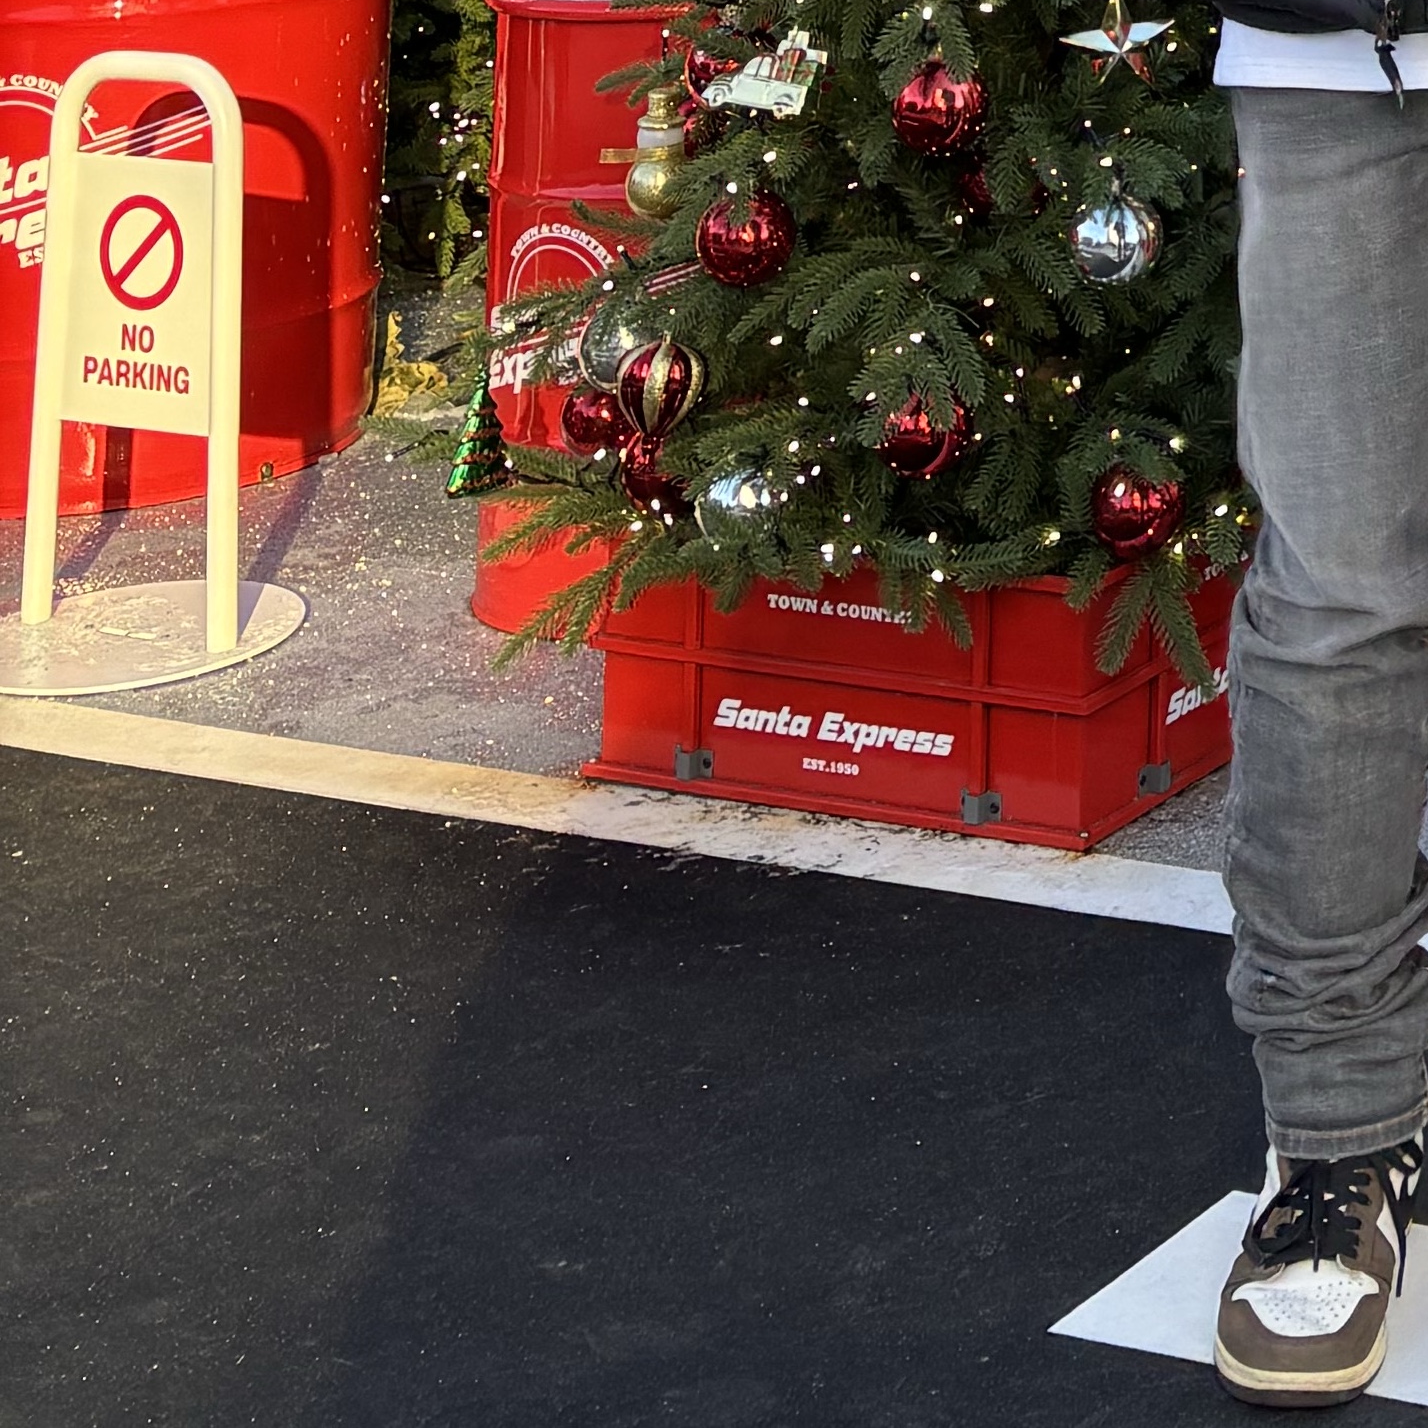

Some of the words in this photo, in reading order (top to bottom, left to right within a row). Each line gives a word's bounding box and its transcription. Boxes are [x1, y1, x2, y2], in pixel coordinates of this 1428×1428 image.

[121, 323, 155, 354] NO
[83, 355, 190, 395] PARKING
[767, 593, 818, 615] TOWN
[820, 600, 834, 616] &
[713, 697, 812, 738] Santa
[816, 711, 955, 757] Express
[802, 757, 860, 776] EST.1950
